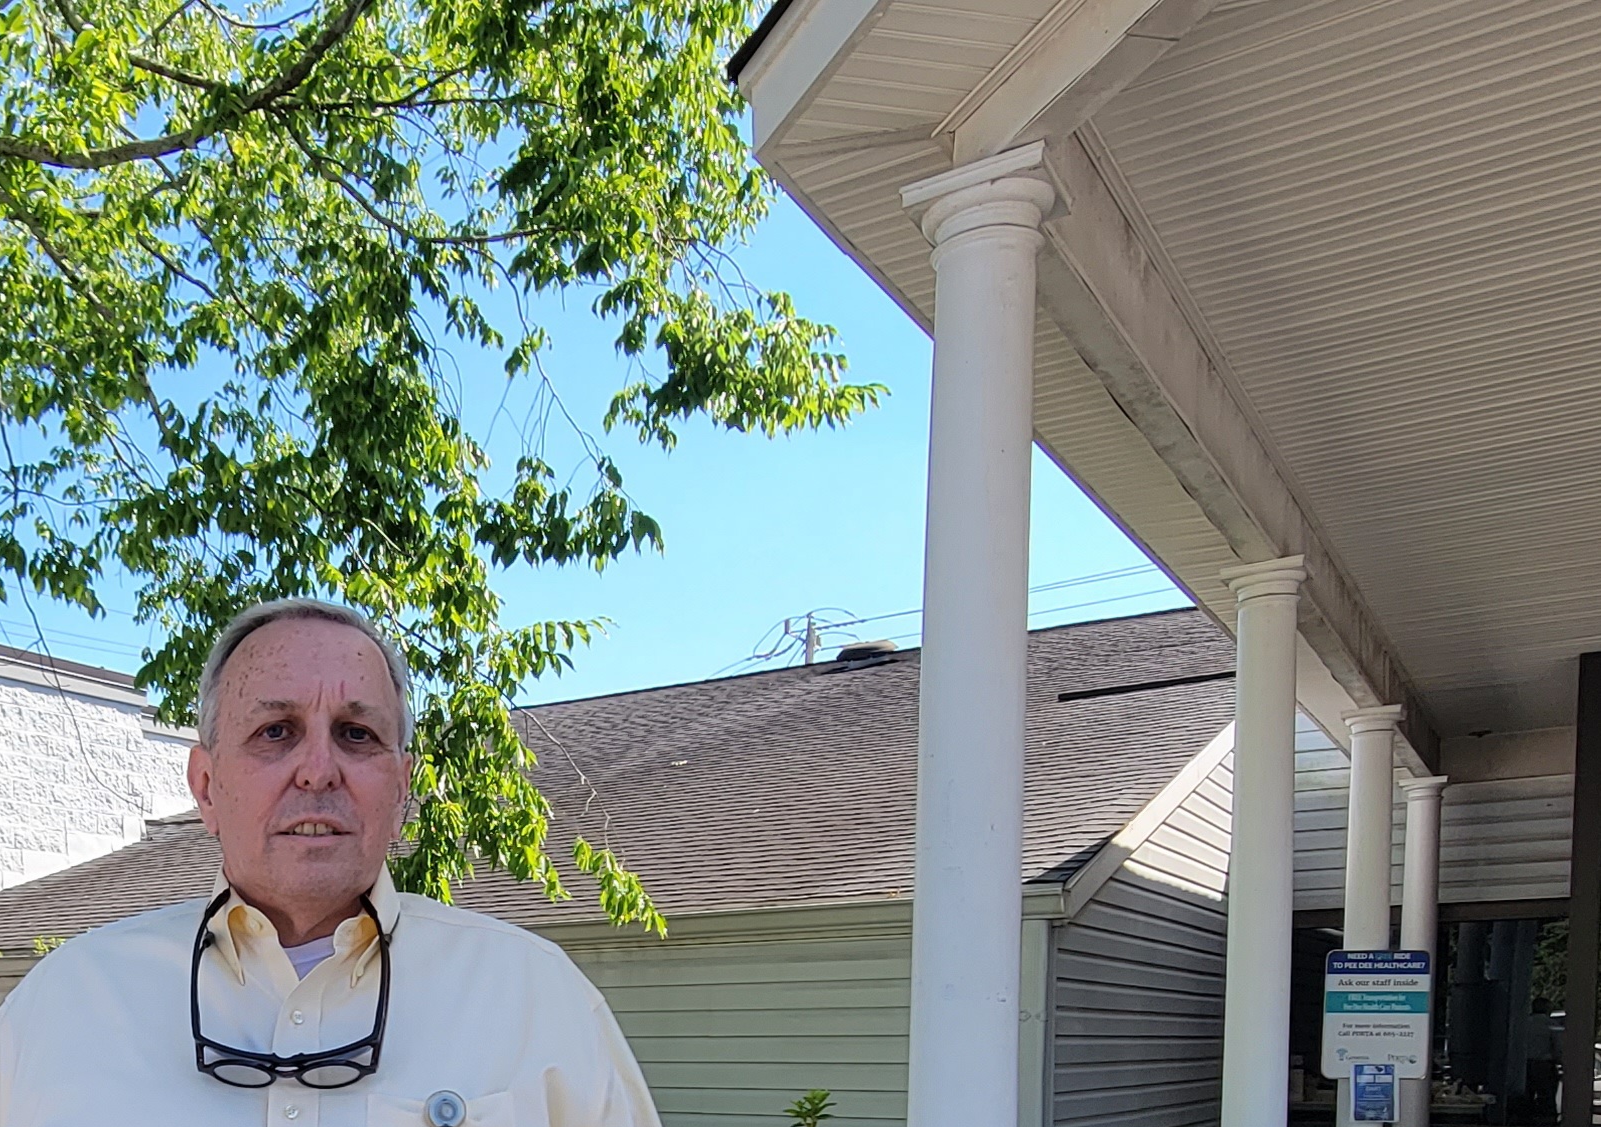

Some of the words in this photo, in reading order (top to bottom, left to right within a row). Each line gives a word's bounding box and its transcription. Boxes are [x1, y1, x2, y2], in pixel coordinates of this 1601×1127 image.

[1347, 952, 1368, 960] NEED
[1368, 952, 1374, 960] A
[1338, 978, 1354, 987] Ask
[1372, 978, 1391, 987] staff
[1393, 978, 1419, 987] inside
